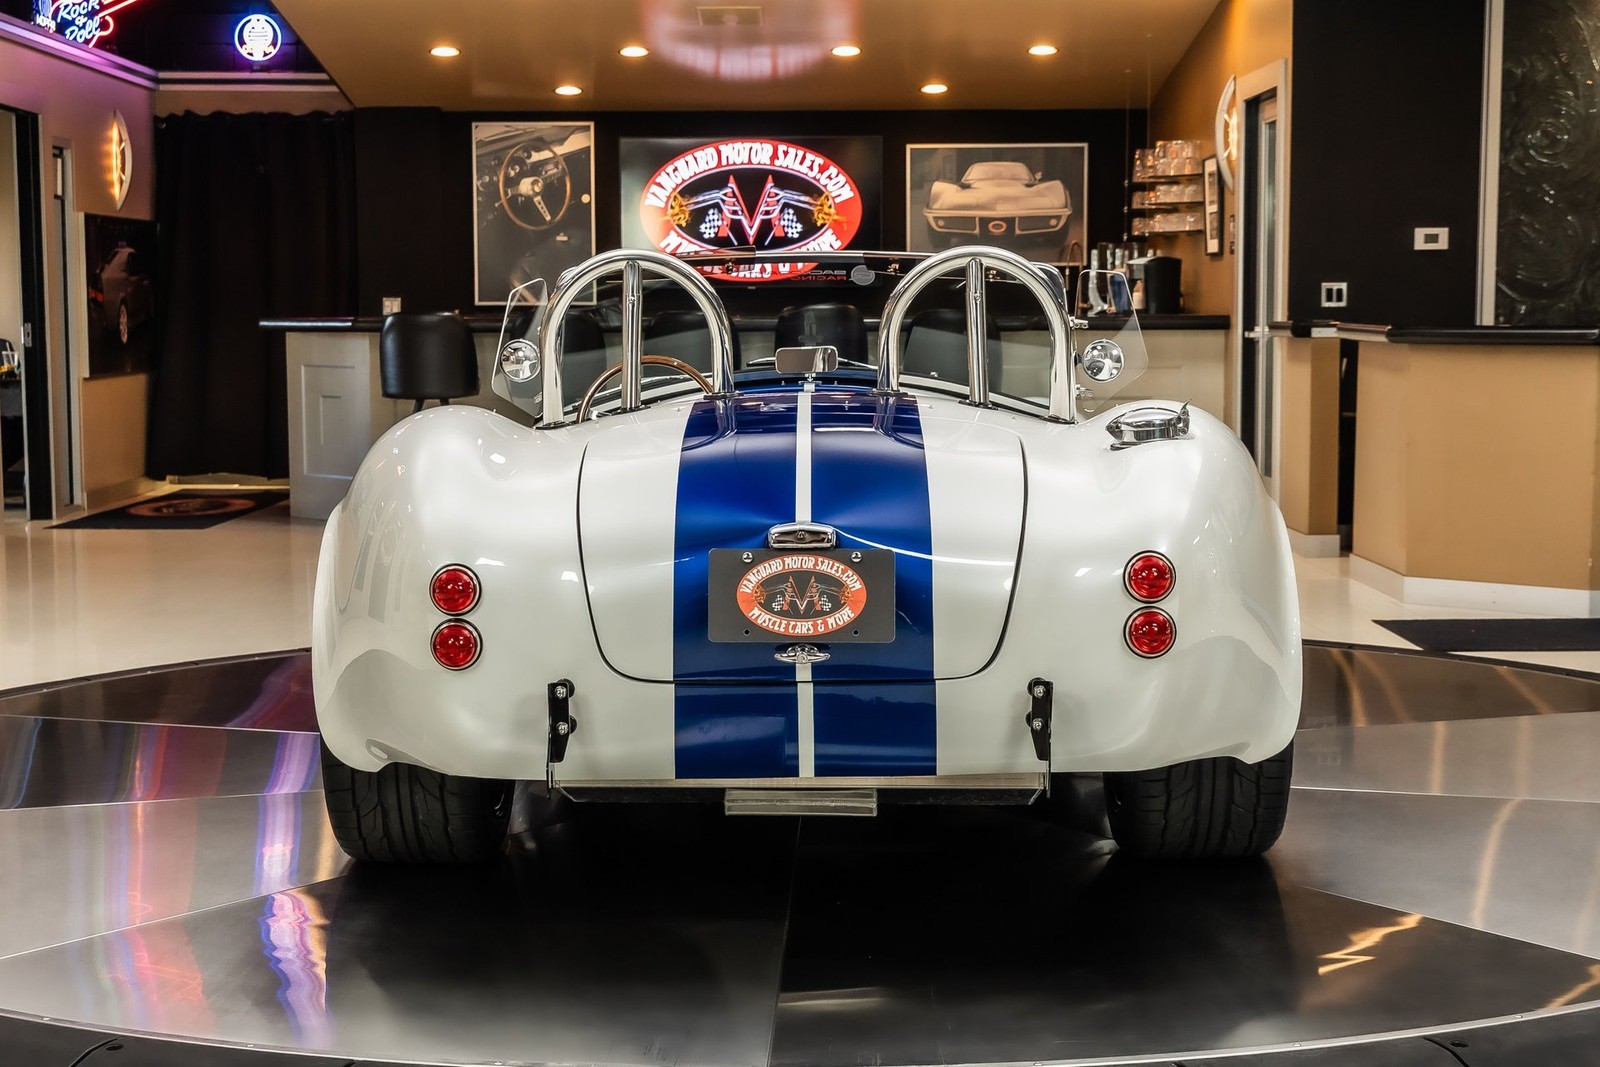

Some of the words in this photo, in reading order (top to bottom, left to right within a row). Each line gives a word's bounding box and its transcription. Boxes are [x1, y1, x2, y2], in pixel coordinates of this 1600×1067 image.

[645, 146, 719, 208] VANGUARD
[718, 142, 774, 166] MOTOR
[774, 144, 855, 204] SALES.COM
[740, 558, 783, 593] VANGUARD
[783, 556, 815, 570] MOTOR
[815, 557, 862, 592] SALES.COM
[748, 606, 788, 633] MUSCLE
[788, 621, 814, 634] CARS
[815, 619, 825, 632] &
[825, 606, 855, 630] MORE
